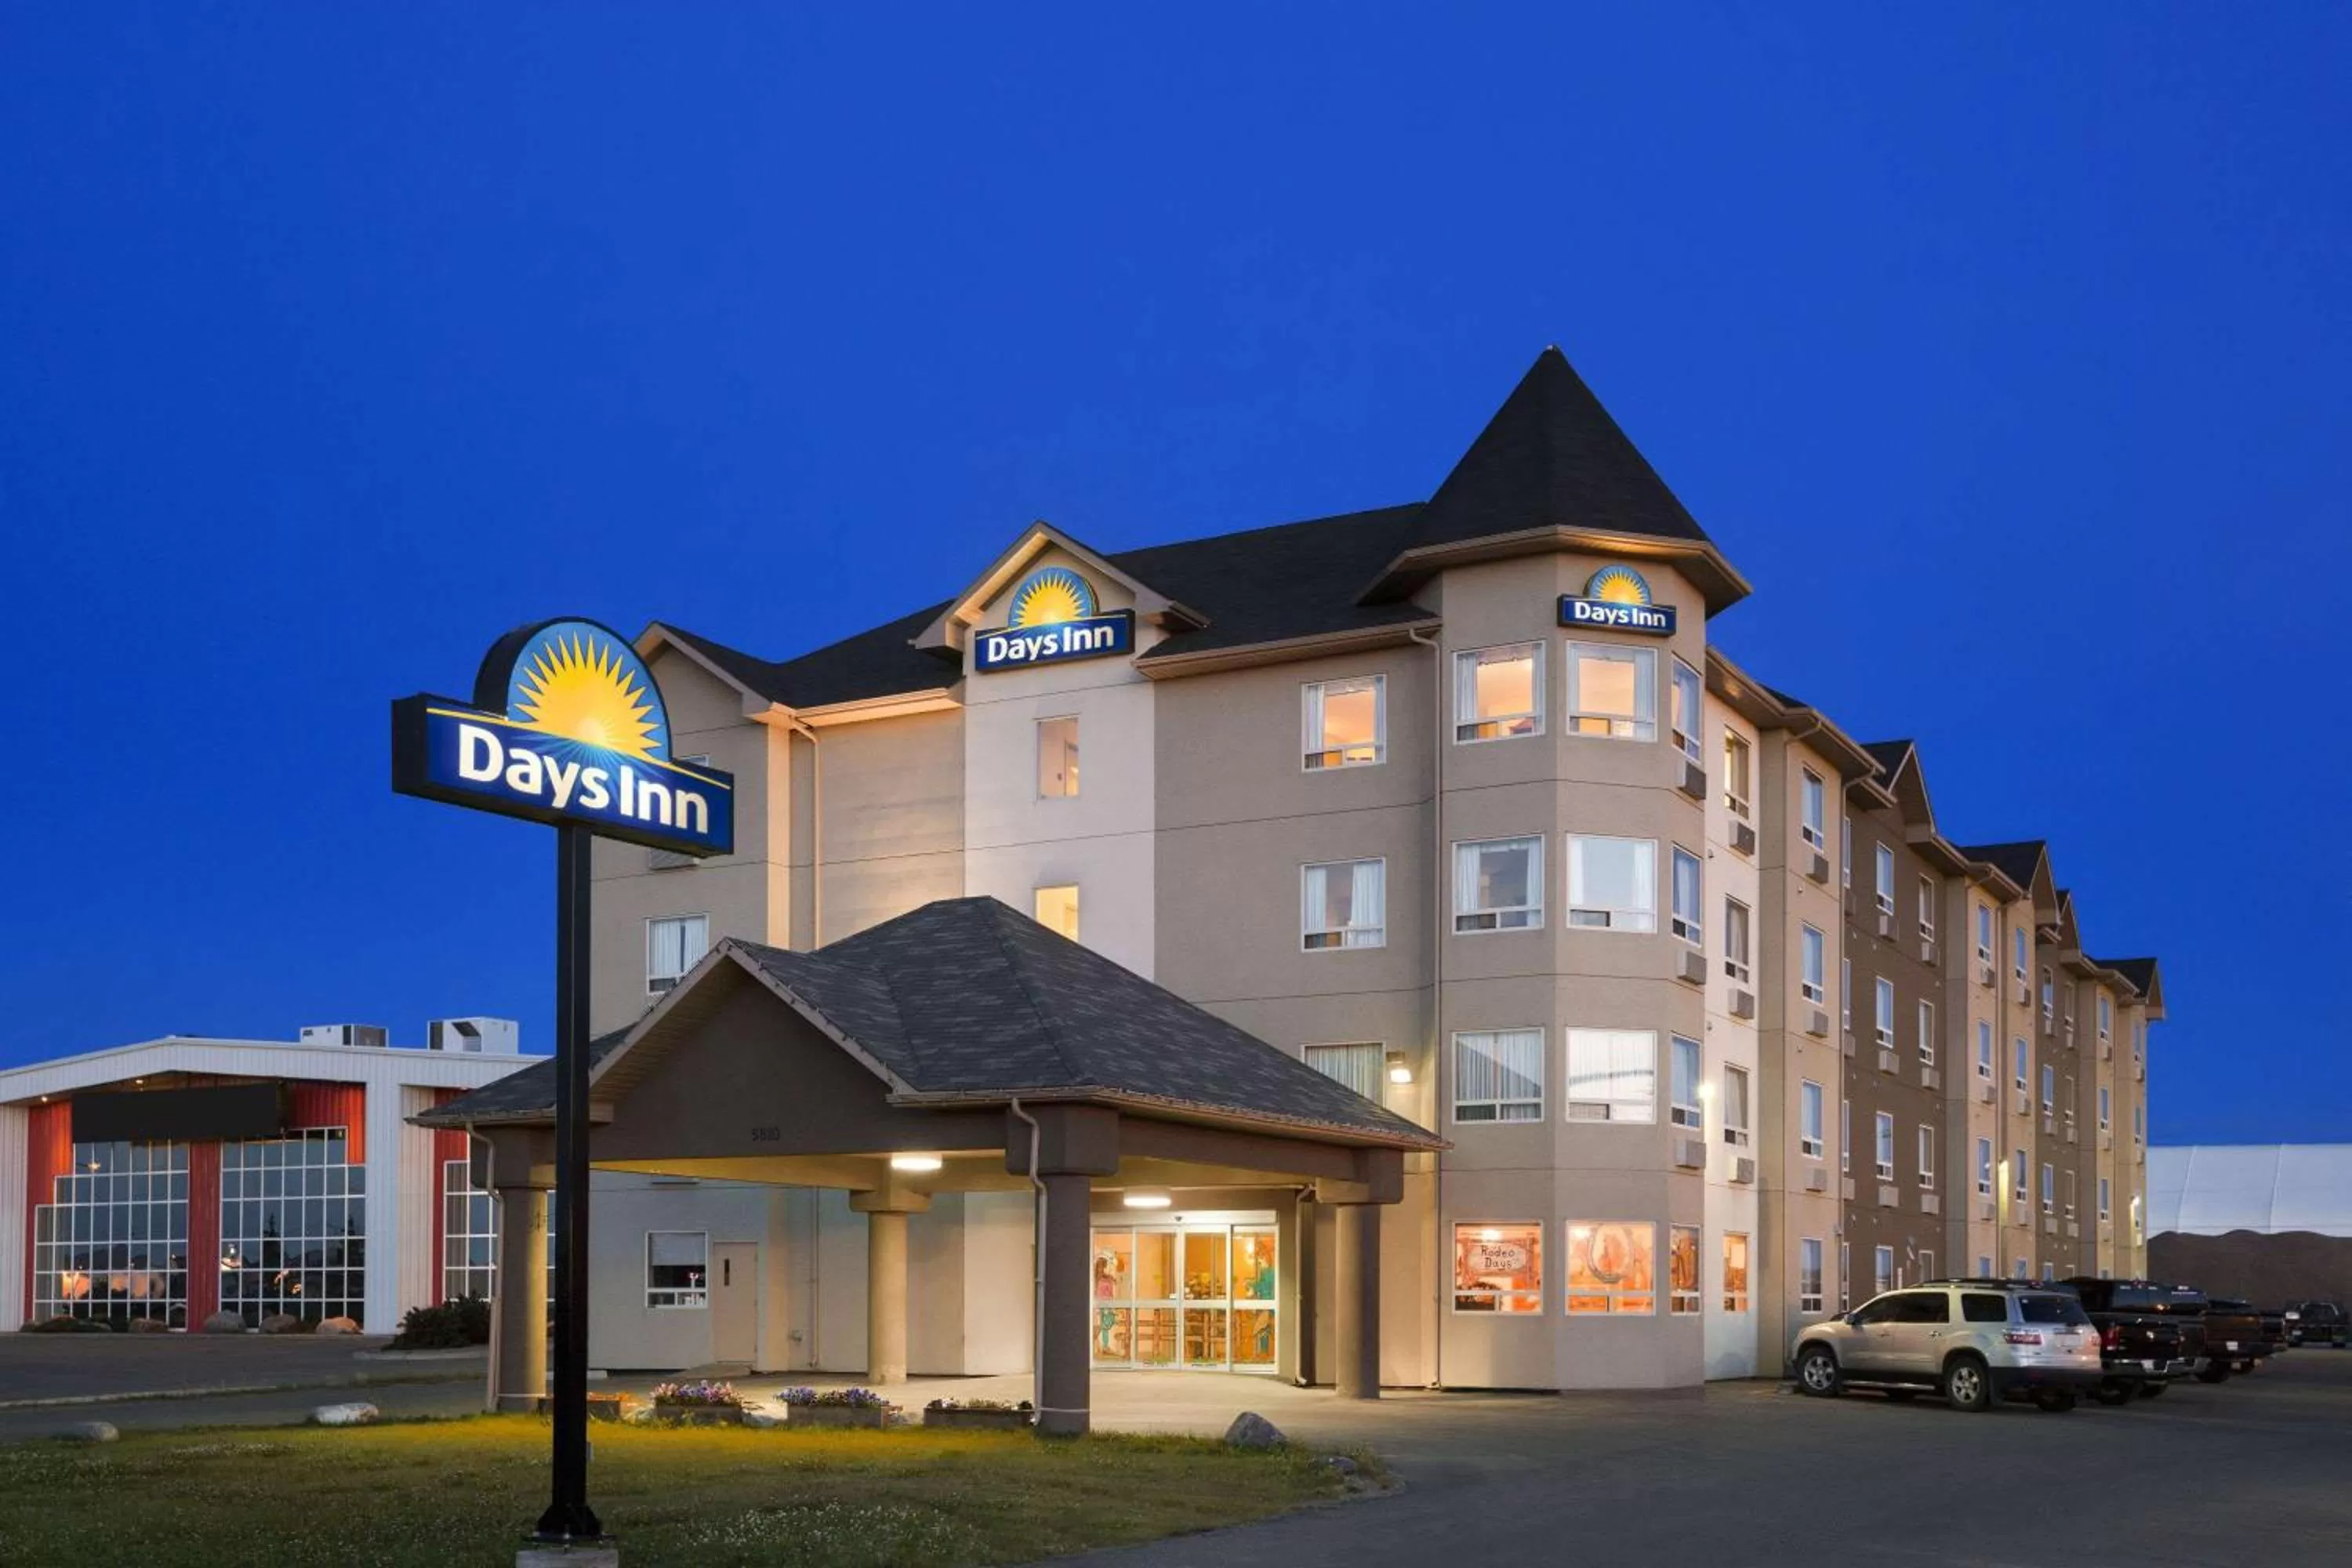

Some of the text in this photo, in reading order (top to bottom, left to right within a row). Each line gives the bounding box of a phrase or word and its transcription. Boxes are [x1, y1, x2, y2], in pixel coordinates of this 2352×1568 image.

[1574, 601, 1666, 627] Days Inn
[988, 626, 1114, 662] Days Inn
[459, 724, 708, 833] Days Inn
[1481, 1245, 1515, 1258] Rodeo
